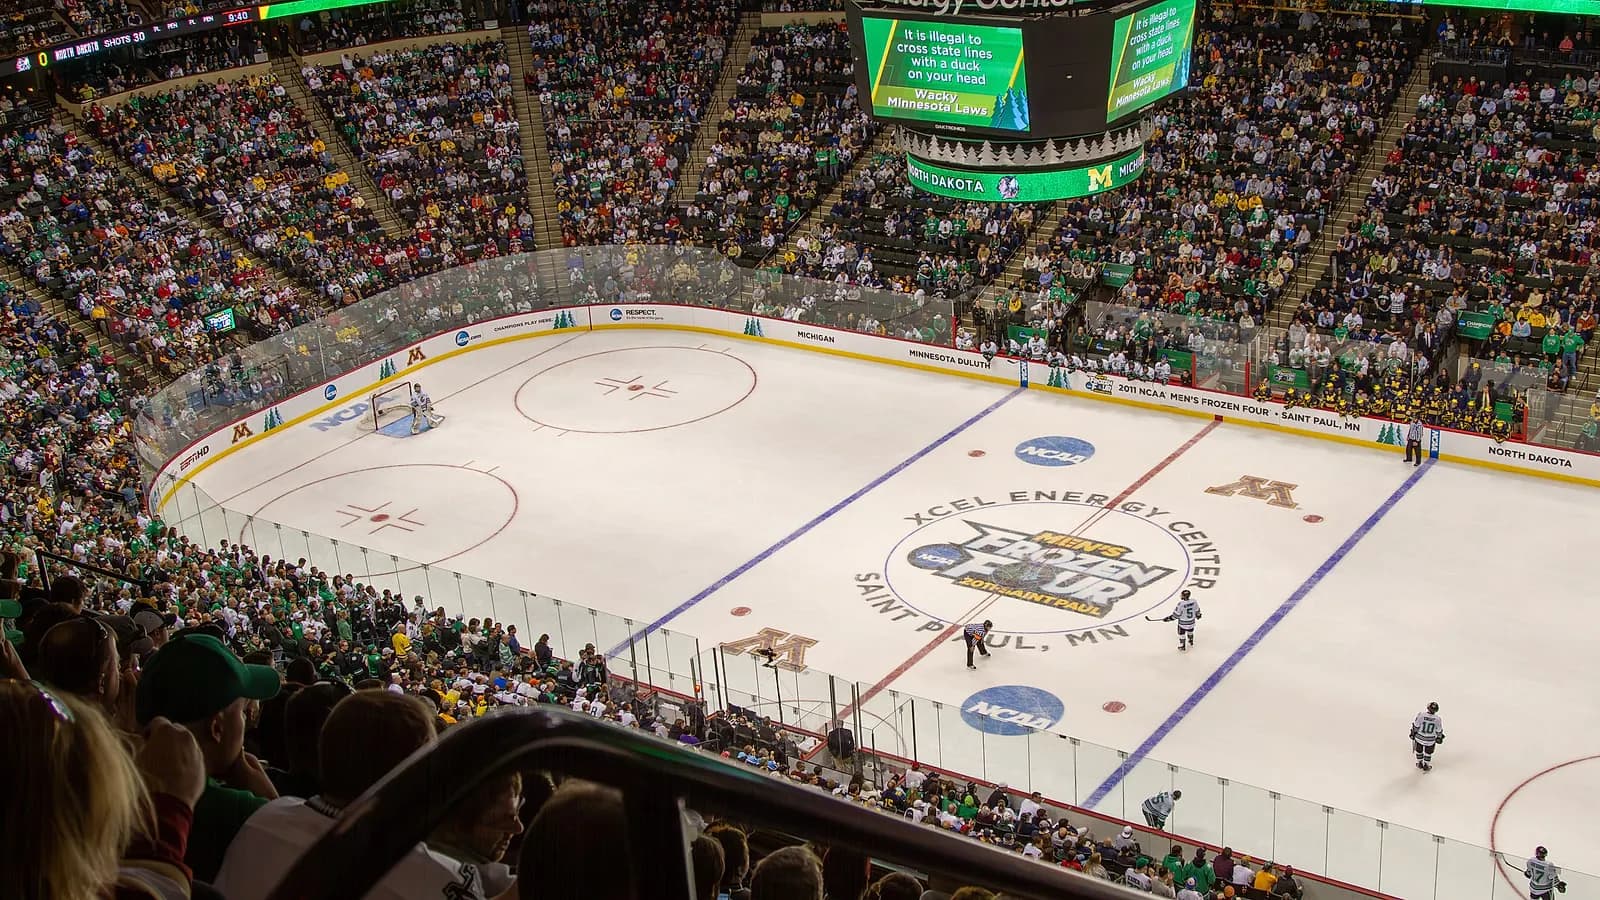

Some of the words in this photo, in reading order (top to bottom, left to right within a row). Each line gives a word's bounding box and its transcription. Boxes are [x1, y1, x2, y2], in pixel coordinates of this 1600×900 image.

[228, 11, 248, 22] 9:40
[1136, 19, 1142, 30] It
[1142, 17, 1148, 28] is
[1149, 8, 1169, 24] illegal
[1169, 8, 1177, 17] to
[904, 29, 913, 40] It
[916, 30, 926, 41] is
[930, 31, 965, 45] illegal
[969, 34, 982, 45] to
[1130, 32, 1147, 46] cross
[1148, 23, 1165, 38] state
[1165, 18, 1180, 31] lines
[38, 52, 48, 66] 0
[55, 49, 75, 61] NORTH
[76, 41, 99, 56] DAKOTA
[104, 35, 131, 48] SHOTS
[133, 31, 145, 42] 30
[897, 43, 928, 54] cross
[931, 45, 961, 57] state
[965, 47, 993, 59] lines
[1136, 42, 1150, 56] with
[1157, 33, 1173, 46] duck
[911, 56, 937, 68] with
[940, 60, 947, 68] a
[951, 59, 980, 71] duck
[1132, 60, 1141, 71] on
[1142, 53, 1156, 68] your
[1157, 45, 1173, 57] head
[908, 70, 922, 79] on
[927, 72, 953, 83] your
[957, 73, 986, 85] head
[1133, 71, 1156, 88] Wacky
[915, 89, 958, 103] Wacky
[1116, 87, 1151, 107] Minnesota
[1152, 78, 1170, 91] Laws
[888, 97, 951, 112] Minnesota
[955, 104, 988, 115] Laws
[931, 173, 984, 192] DAKOTA
[1087, 165, 1113, 191] M
[493, 322, 524, 331] CHAMPIONS
[797, 330, 835, 344] MICHIGAN
[909, 349, 956, 364] MINNESOTA
[957, 357, 991, 370] DULUTH
[1118, 384, 1136, 394] 2011
[1139, 388, 1166, 400] NCAA
[1170, 392, 1199, 404] MEN'S
[1201, 397, 1239, 411] FROZEN
[1242, 404, 1269, 416] FOUR
[1282, 411, 1311, 424] SAINT
[1313, 416, 1342, 431] PAUL,
[1344, 421, 1360, 432] MN
[1018, 446, 1088, 463] NCAA
[1488, 447, 1526, 460] NORTH
[1528, 453, 1572, 468] DAKOTA
[1204, 475, 1299, 509] M
[904, 496, 996, 526] XCEL
[1009, 490, 1170, 518] ENERGY
[1168, 521, 1220, 589] CENTER
[1033, 532, 1125, 557] MEN'S
[965, 525, 1174, 585] FROZEN
[943, 553, 1136, 604] FOUR
[855, 573, 919, 621] SAINT
[1066, 624, 1130, 647] MN
[1054, 597, 1101, 614] PAUL
[1186, 608, 1193, 618] 5
[720, 626, 820, 672] M
[965, 701, 1052, 729] NCAA
[1422, 722, 1435, 733] 10
